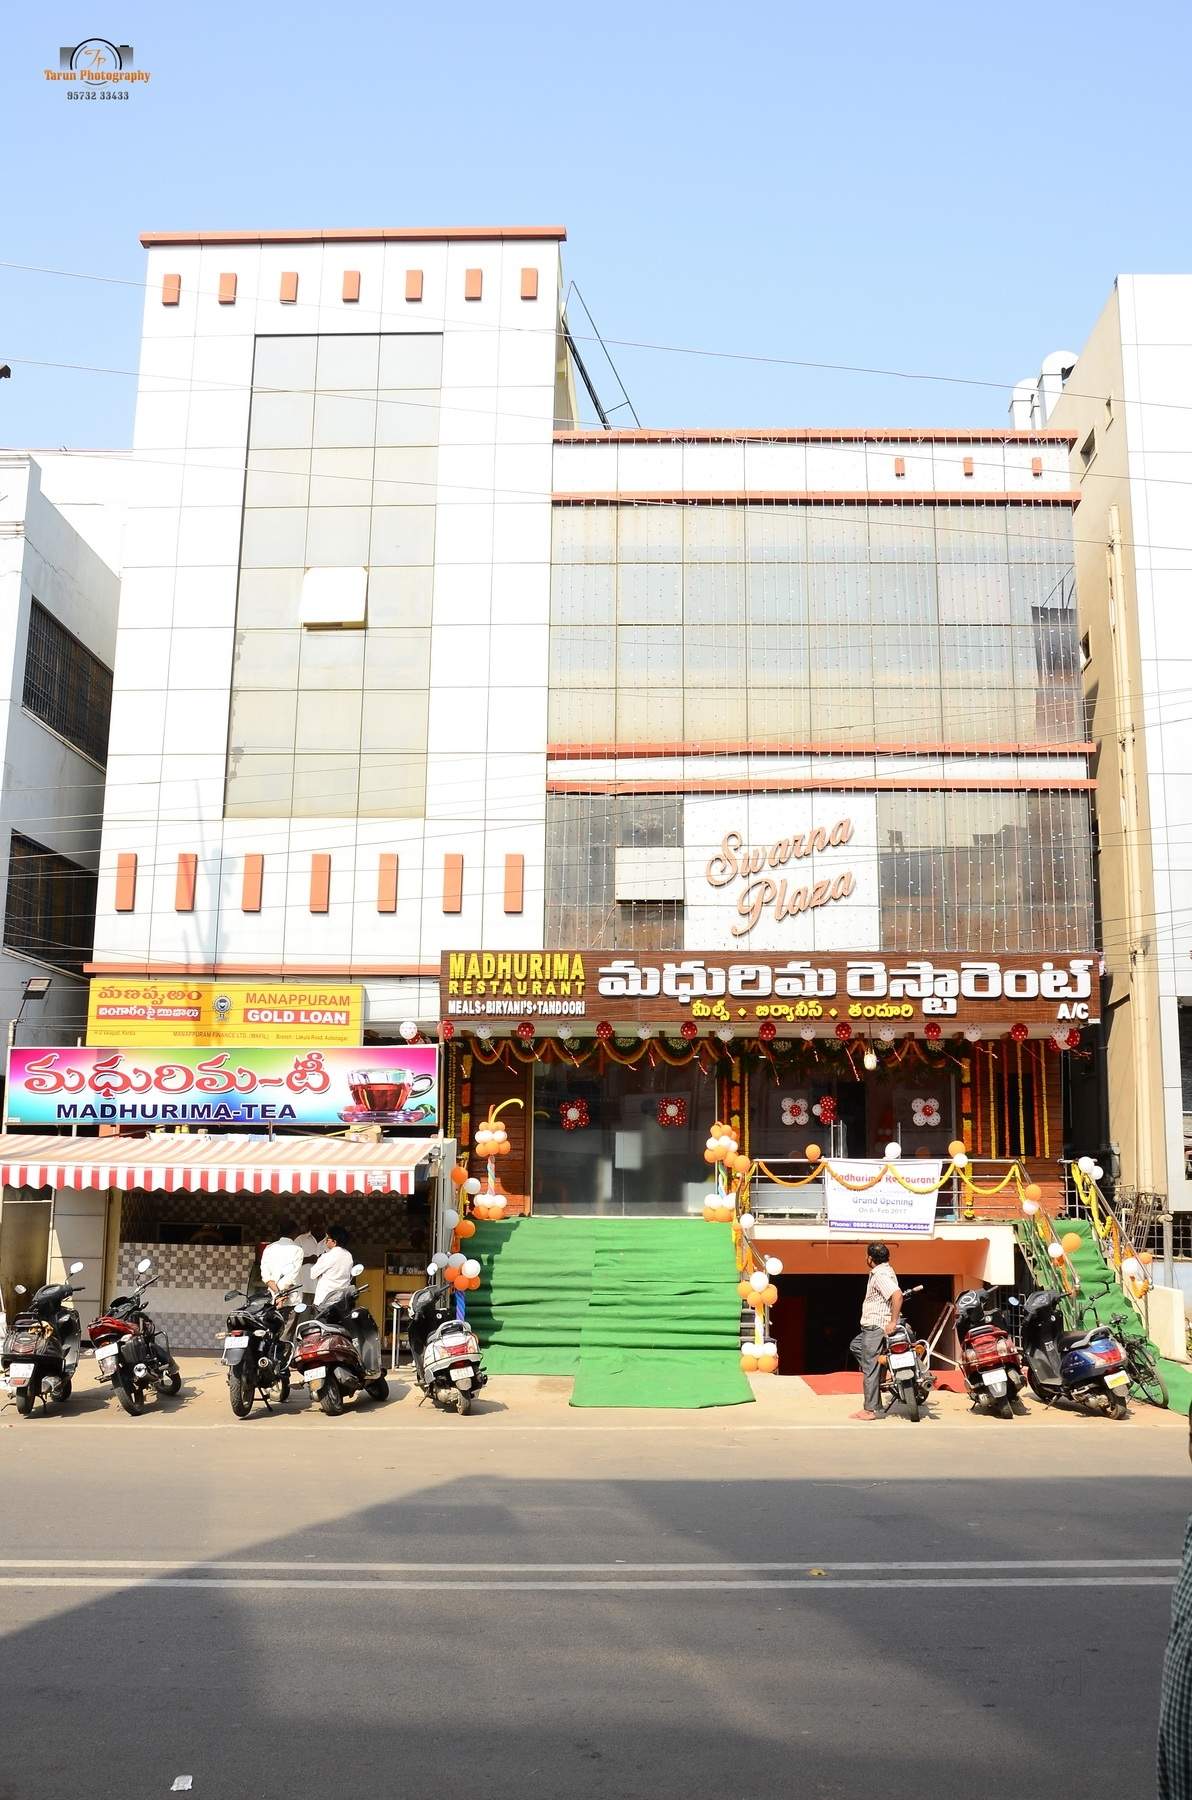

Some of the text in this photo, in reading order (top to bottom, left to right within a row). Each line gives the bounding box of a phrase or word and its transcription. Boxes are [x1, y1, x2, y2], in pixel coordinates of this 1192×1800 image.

[706, 818, 854, 886] Swarna
[731, 871, 856, 937] Plaza
[449, 952, 586, 981] MADHURIMA
[448, 980, 586, 996] RESTAURANT
[597, 959, 837, 1004] మధురిమ
[246, 992, 351, 1007] MANAPPURAM
[448, 1000, 482, 1014] MEALS
[537, 1000, 586, 1016] TANDOORI
[1056, 1003, 1089, 1020] A/C
[247, 1009, 347, 1025] GOLD LOAN
[56, 1103, 297, 1119] MADHURIMA-TEA
[852, 1197, 913, 1207] Grand Opening
